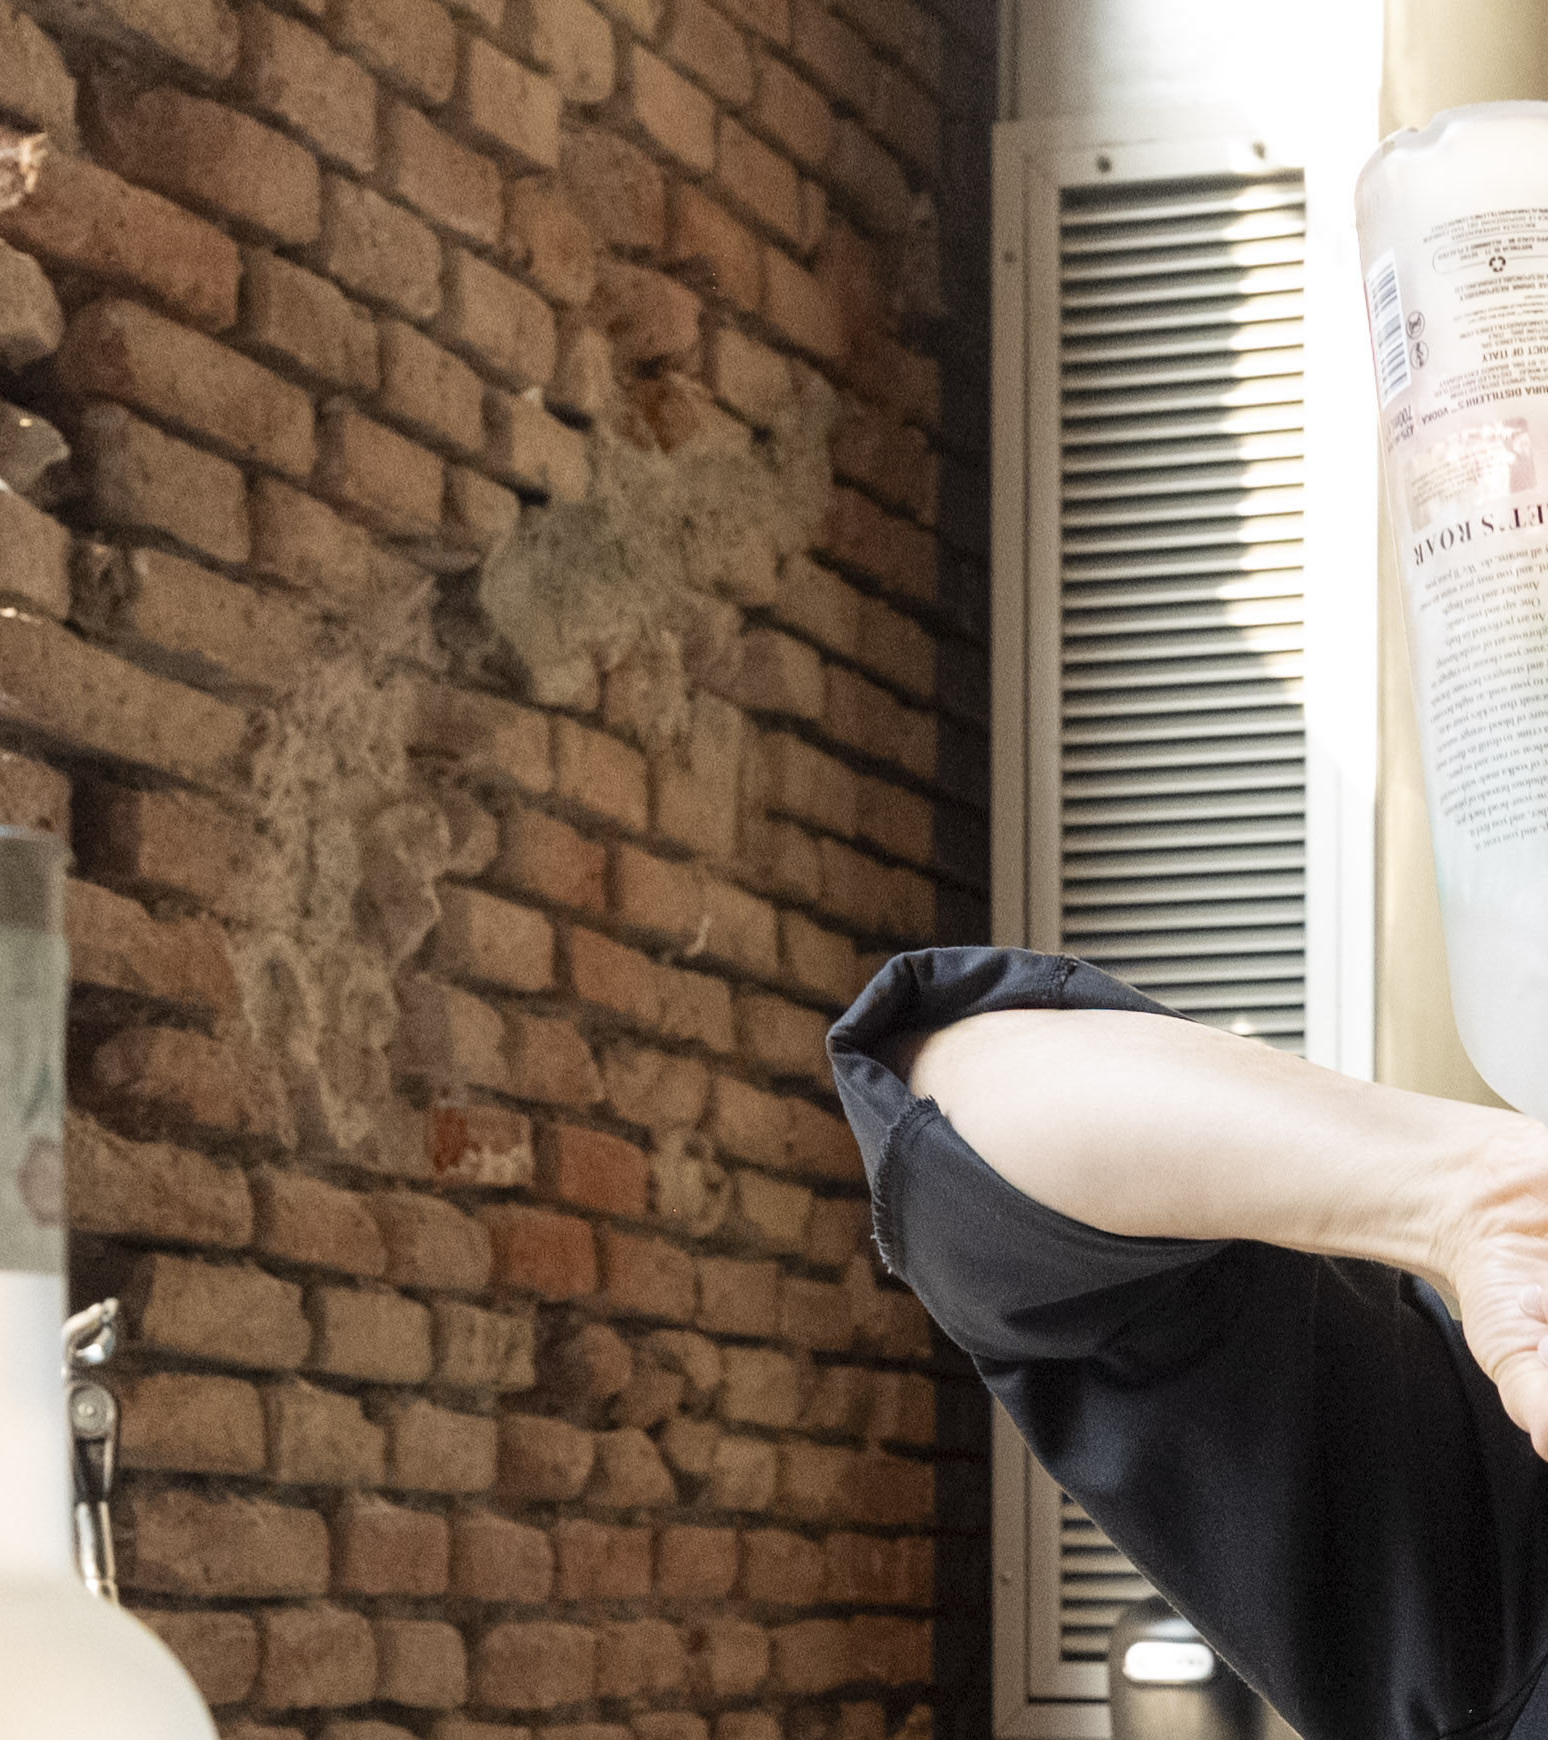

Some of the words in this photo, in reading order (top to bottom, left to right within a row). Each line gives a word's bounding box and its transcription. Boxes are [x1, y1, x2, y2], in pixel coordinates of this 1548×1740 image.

[1482, 349, 1507, 362] ITALY
[1512, 347, 1523, 356] OF
[1421, 406, 1447, 424] VODKA
[1415, 520, 1470, 565] ROAR
[1531, 547, 1541, 558] all
[1477, 571, 1493, 584] may
[1496, 566, 1511, 579] you
[1515, 565, 1533, 577] and
[1501, 579, 1539, 596] Another
[1464, 592, 1478, 605] you
[1482, 588, 1497, 603] and
[1520, 596, 1540, 609] One
[1467, 608, 1481, 621] you
[1485, 605, 1499, 618] and
[1532, 612, 1545, 622] An
[1470, 615, 1514, 640] perfected
[1508, 625, 1548, 644] glorious
[1503, 647, 1520, 659] you
[1483, 662, 1523, 683] strangers
[1527, 661, 1543, 673] and
[1510, 677, 1529, 690] your
[1533, 677, 1543, 687] to
[1500, 699, 1516, 712] that
[1489, 716, 1514, 732] blood
[1524, 742, 1548, 756] wheat
[1474, 756, 1488, 770] and
[1502, 763, 1527, 778] vodka
[1478, 770, 1499, 786] made
[1492, 816, 1506, 828] you
[1510, 813, 1525, 826] and
[1521, 825, 1537, 839] and
